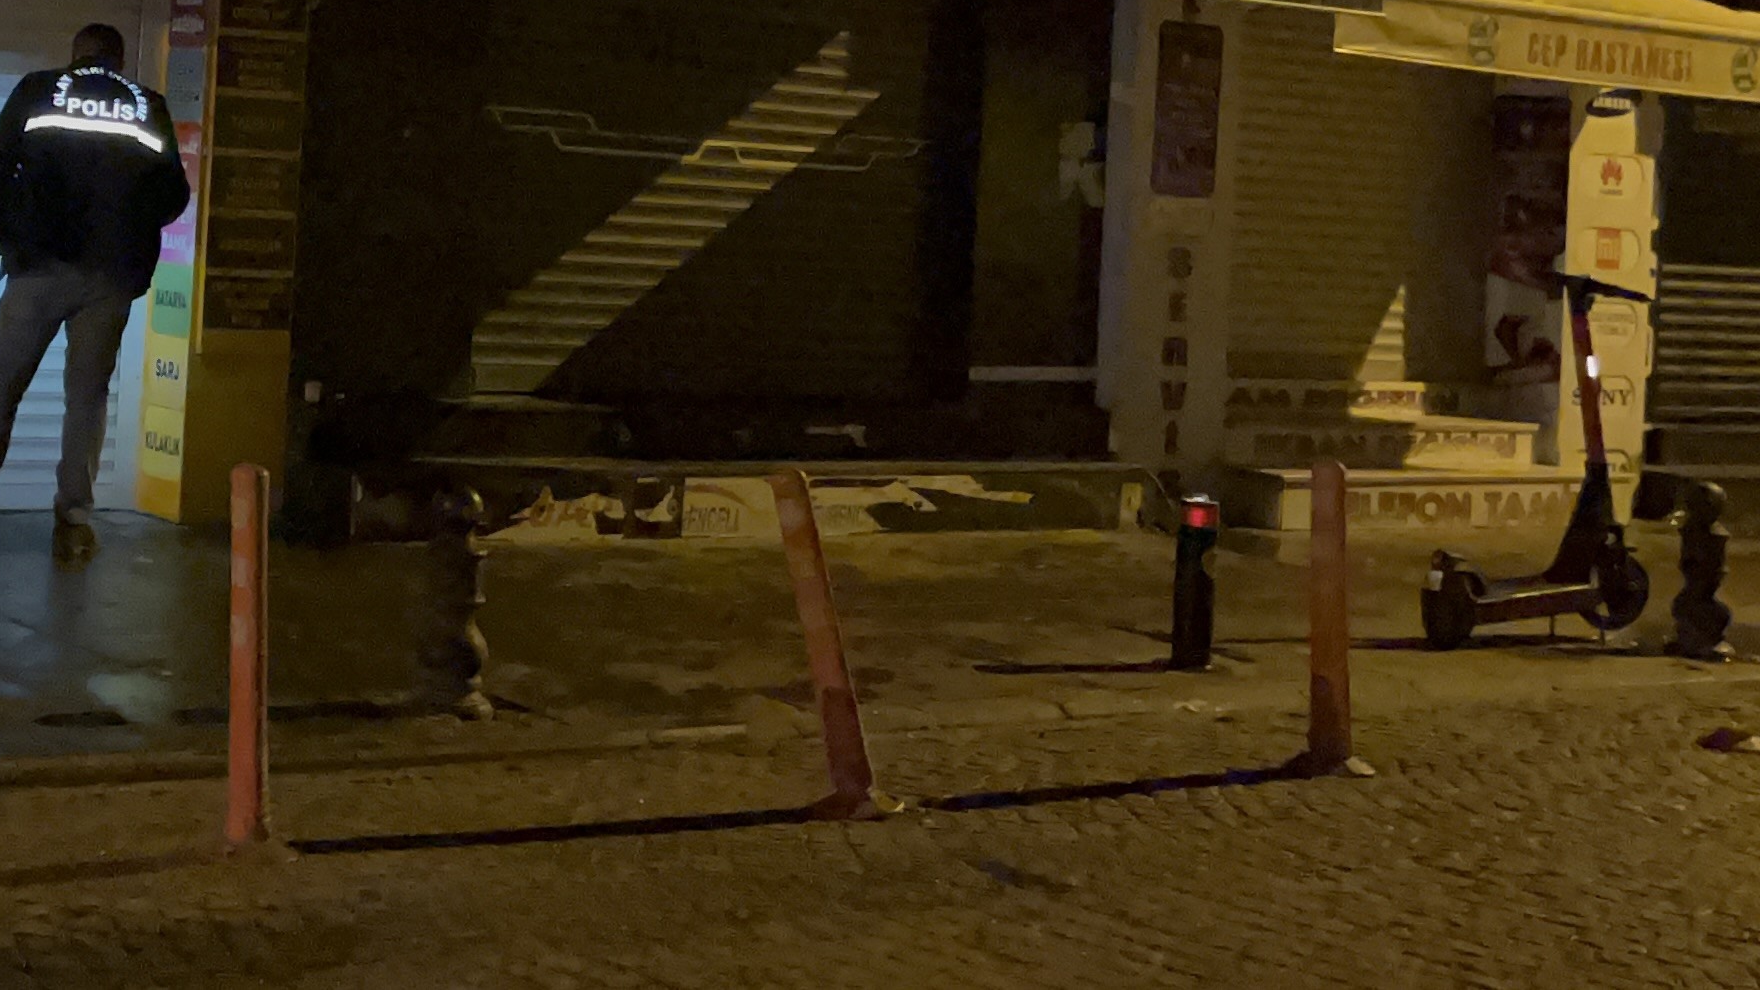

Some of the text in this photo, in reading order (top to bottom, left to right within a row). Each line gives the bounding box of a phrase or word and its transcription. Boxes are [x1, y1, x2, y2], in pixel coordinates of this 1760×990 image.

[1526, 33, 1568, 68] CEP
[66, 97, 135, 122] POLİS
[1572, 387, 1631, 407] SNY
